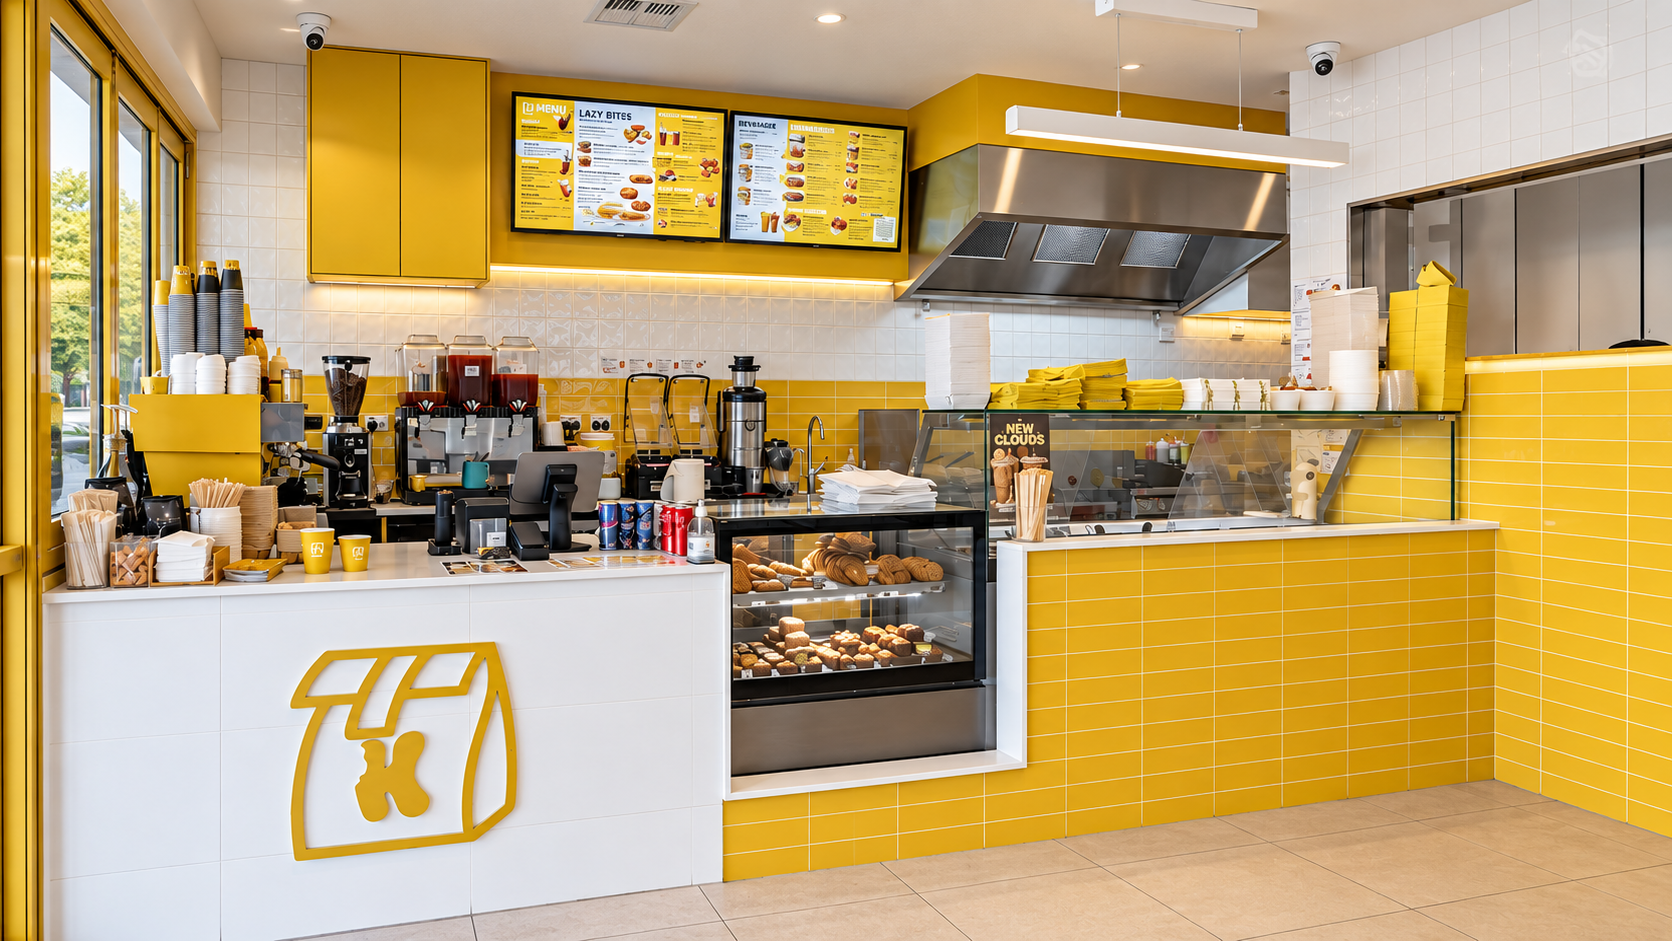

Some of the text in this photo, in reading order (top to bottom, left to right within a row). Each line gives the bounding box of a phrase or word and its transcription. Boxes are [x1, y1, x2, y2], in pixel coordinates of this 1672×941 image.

[536, 103, 567, 114] MENU
[579, 109, 603, 119] LAZY
[606, 111, 632, 121] BITES
[1006, 423, 1034, 434] NEW
[994, 434, 1045, 446] CLOUDS
